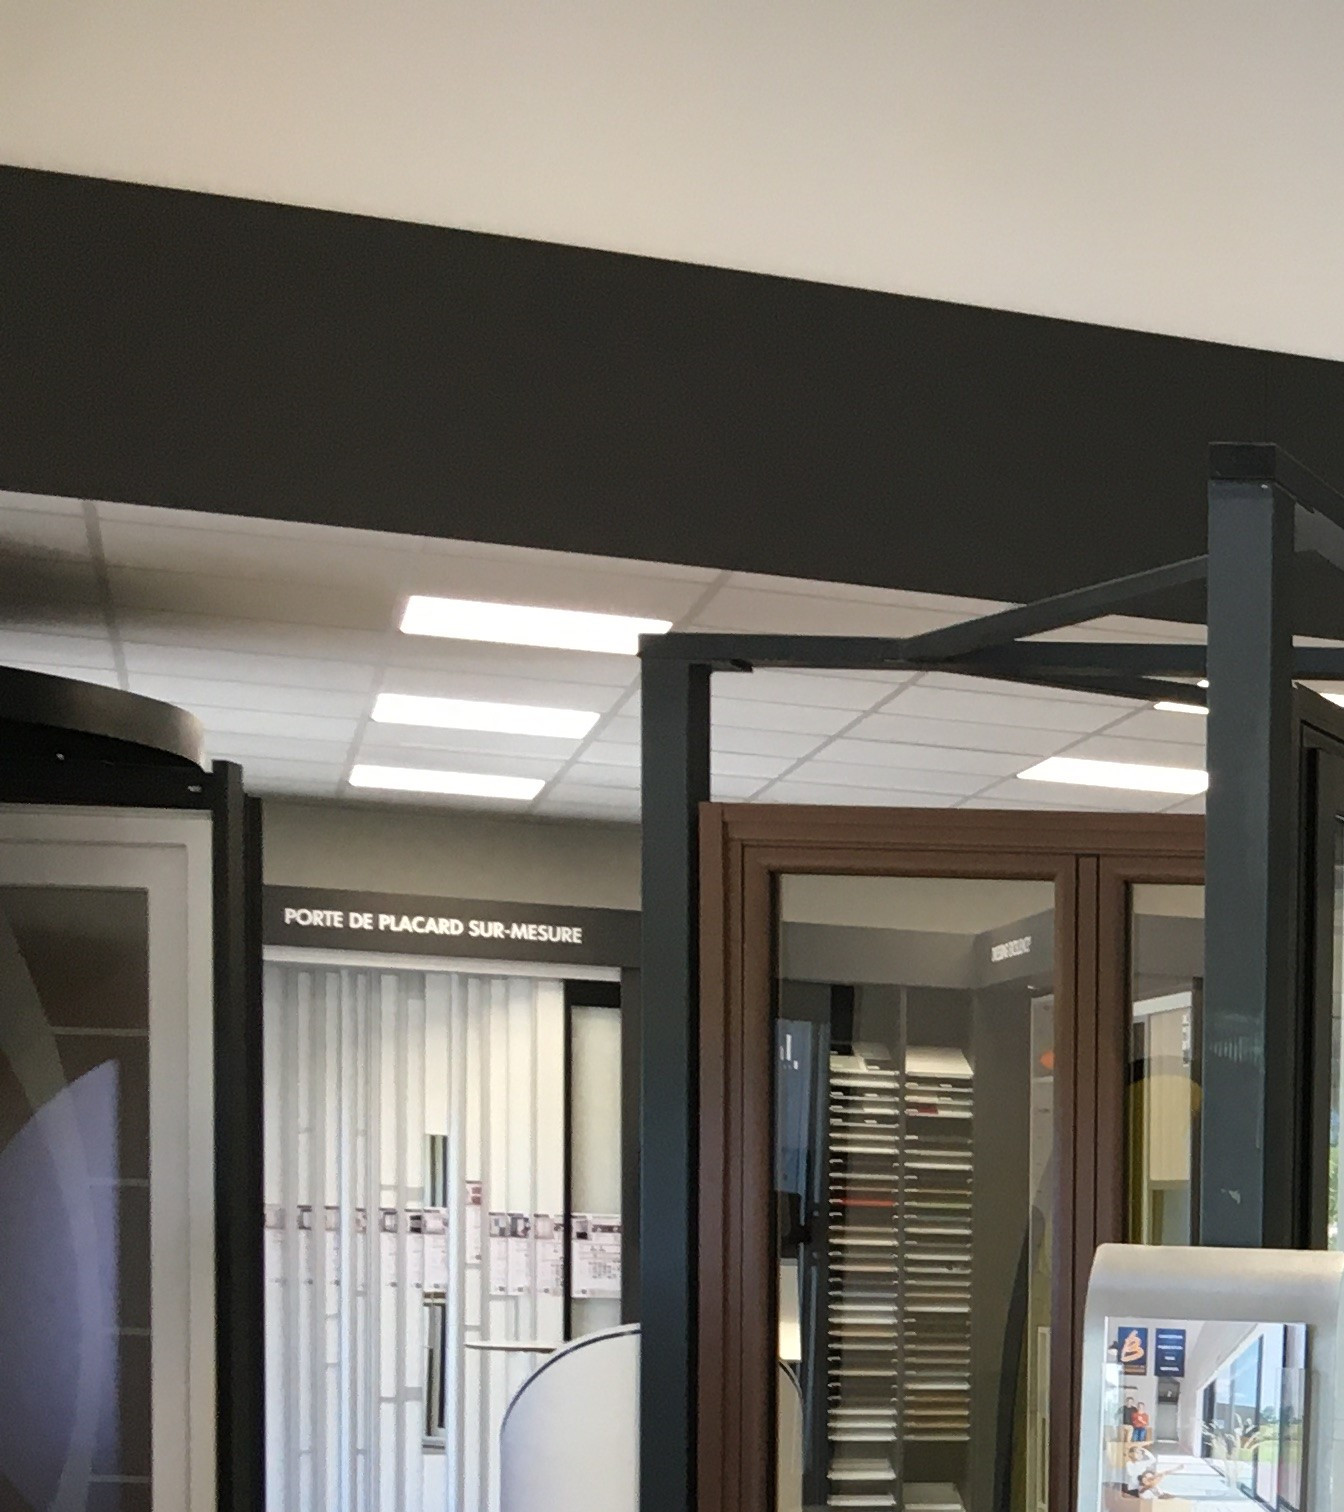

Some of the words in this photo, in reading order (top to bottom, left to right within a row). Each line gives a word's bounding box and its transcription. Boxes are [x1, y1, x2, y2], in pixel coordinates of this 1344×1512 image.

[284, 908, 343, 928] PORTE
[349, 912, 373, 930] DE
[378, 914, 463, 936] PLACARD
[468, 920, 583, 944] SUR-MESURE
